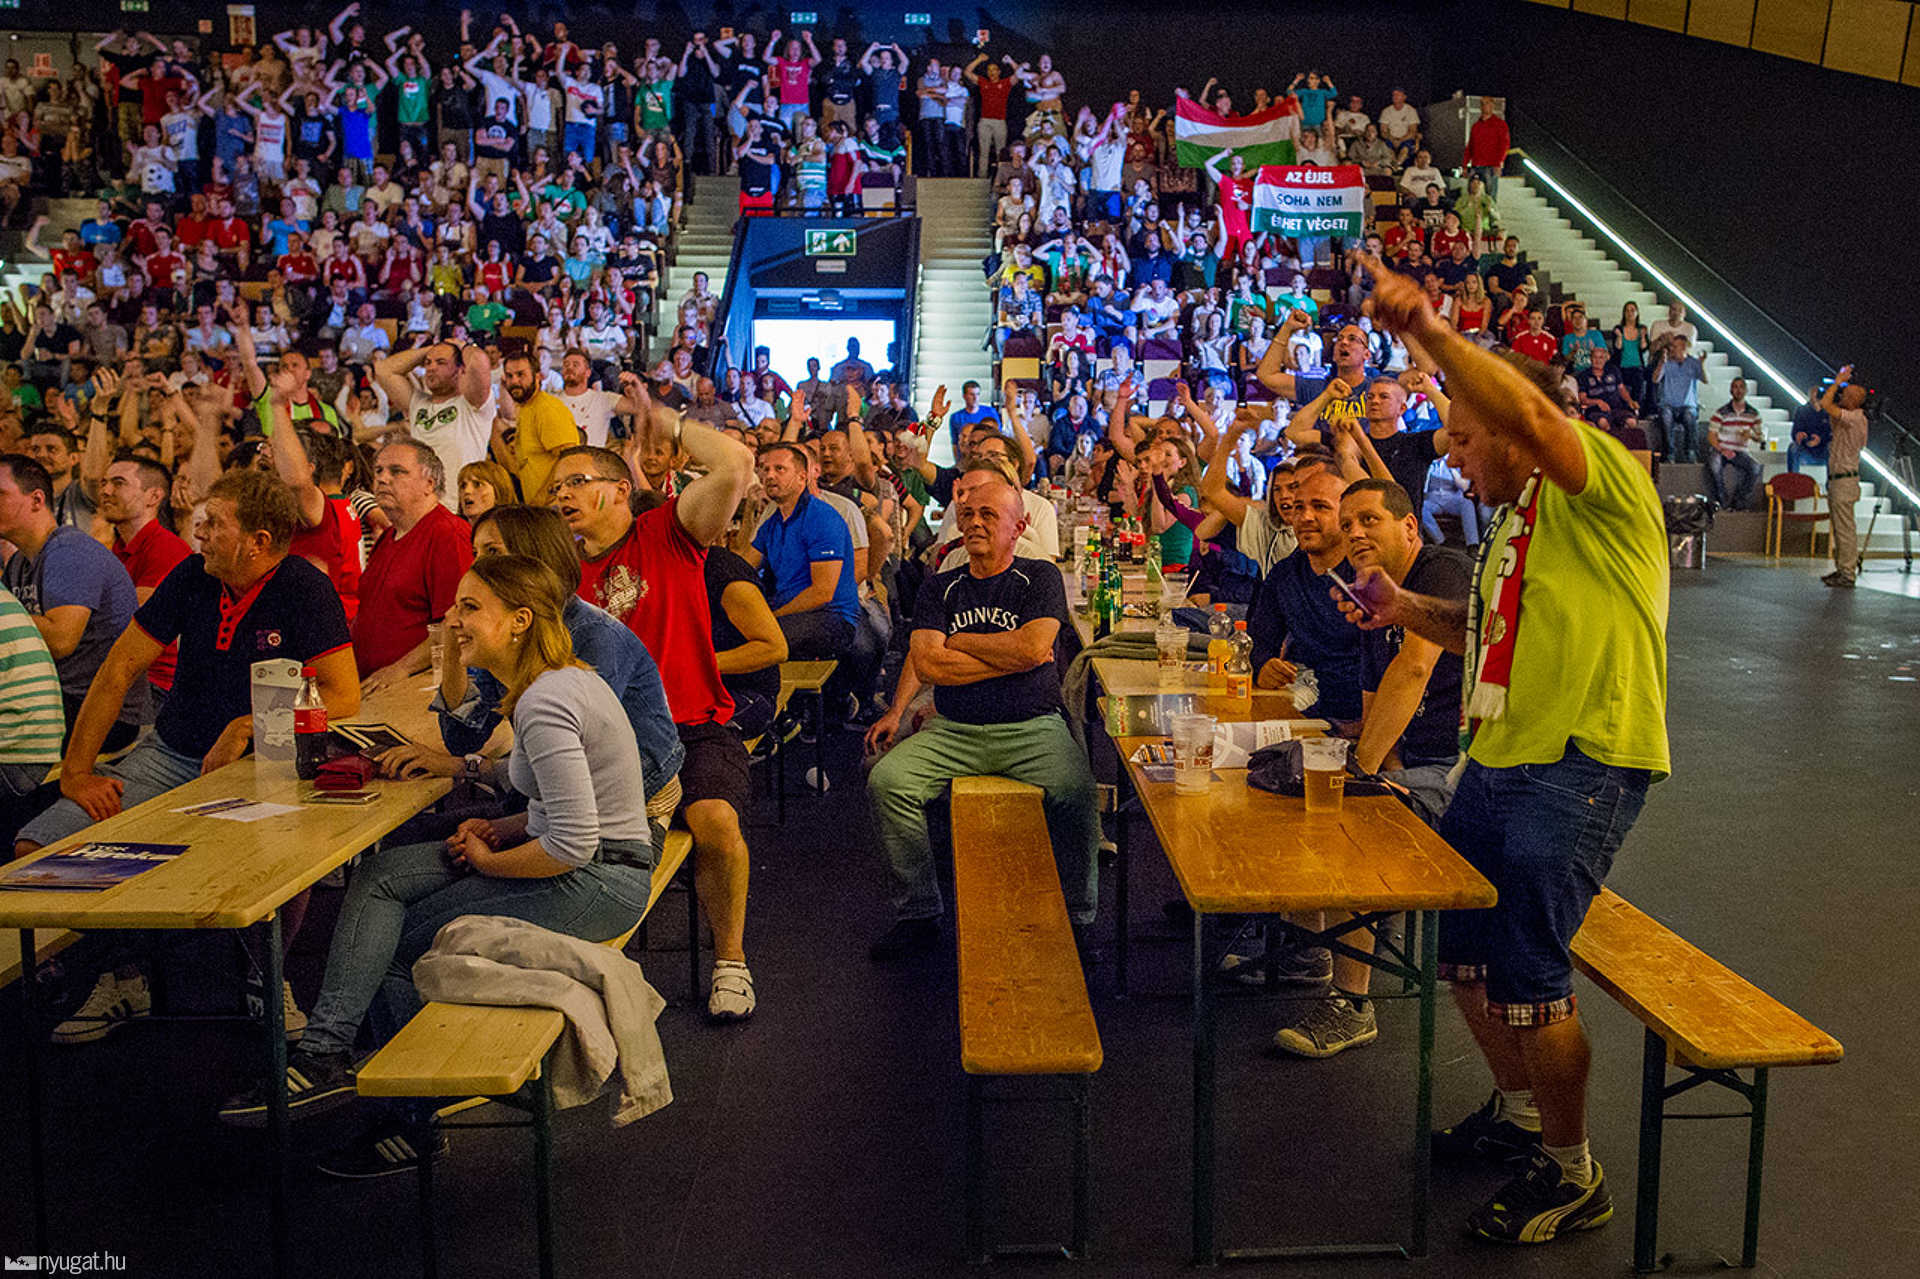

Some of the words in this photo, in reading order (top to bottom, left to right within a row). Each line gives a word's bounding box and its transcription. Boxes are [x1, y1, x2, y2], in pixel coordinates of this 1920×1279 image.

[1285, 171, 1303, 183] AZ
[1304, 168, 1335, 184] ÉJJEL
[1276, 193, 1311, 207] SOHA
[1316, 195, 1343, 207] NEM
[1271, 212, 1303, 231] ÉHET
